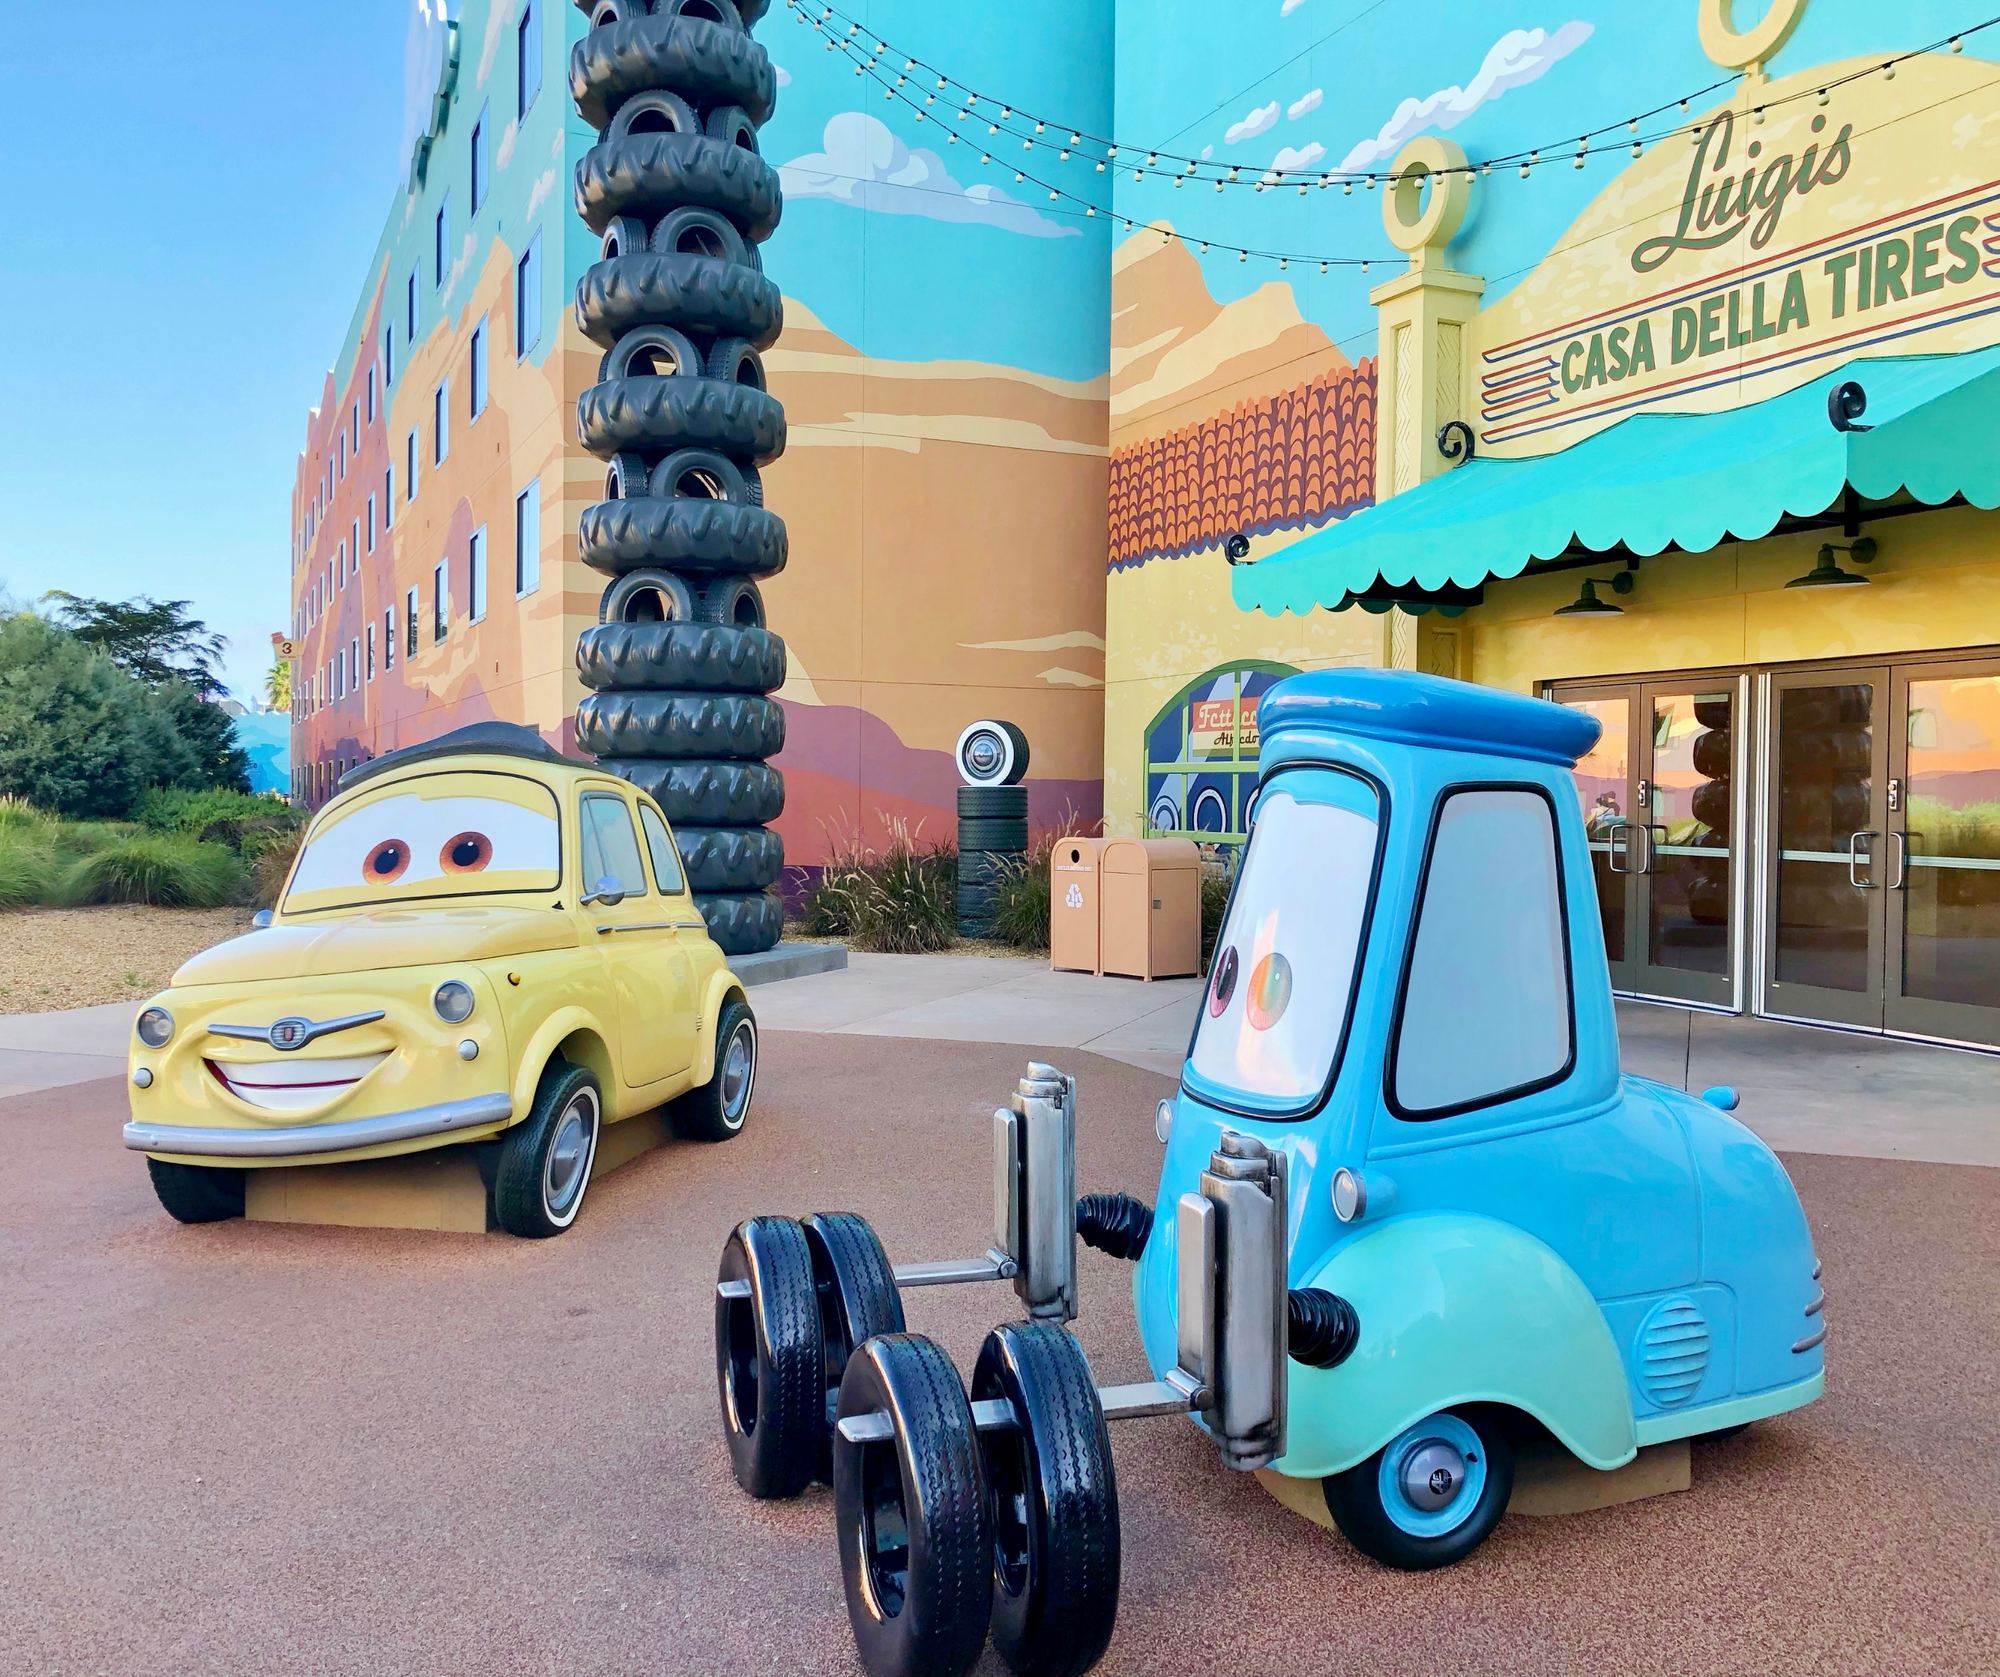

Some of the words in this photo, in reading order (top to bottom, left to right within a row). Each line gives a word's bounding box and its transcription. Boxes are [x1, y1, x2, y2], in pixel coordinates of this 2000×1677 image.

[1561, 319, 1656, 394] CASA
[1671, 270, 1810, 365] DELLA
[1824, 215, 1981, 318] TIRES
[282, 642, 292, 654] 3
[1213, 731, 1260, 747] Alfedo
